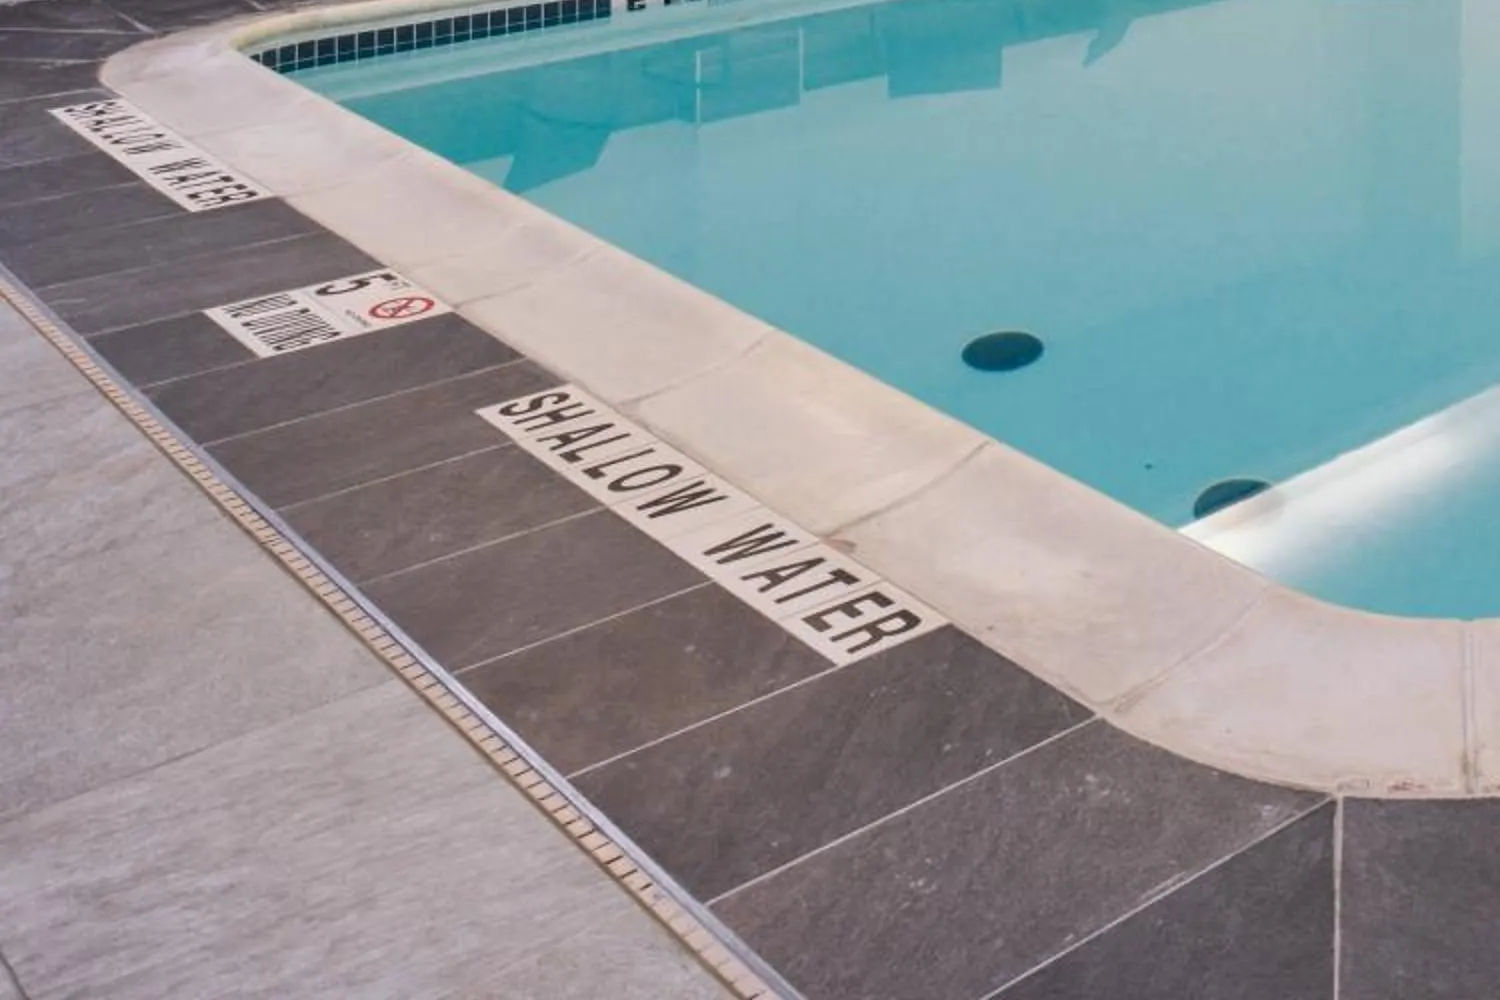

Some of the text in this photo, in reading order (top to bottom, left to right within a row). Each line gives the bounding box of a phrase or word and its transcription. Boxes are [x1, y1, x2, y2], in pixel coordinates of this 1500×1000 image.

[63, 100, 260, 208] SHALLOW WATER
[315, 272, 397, 296] 5
[498, 391, 924, 655] SHALLOW WATER
